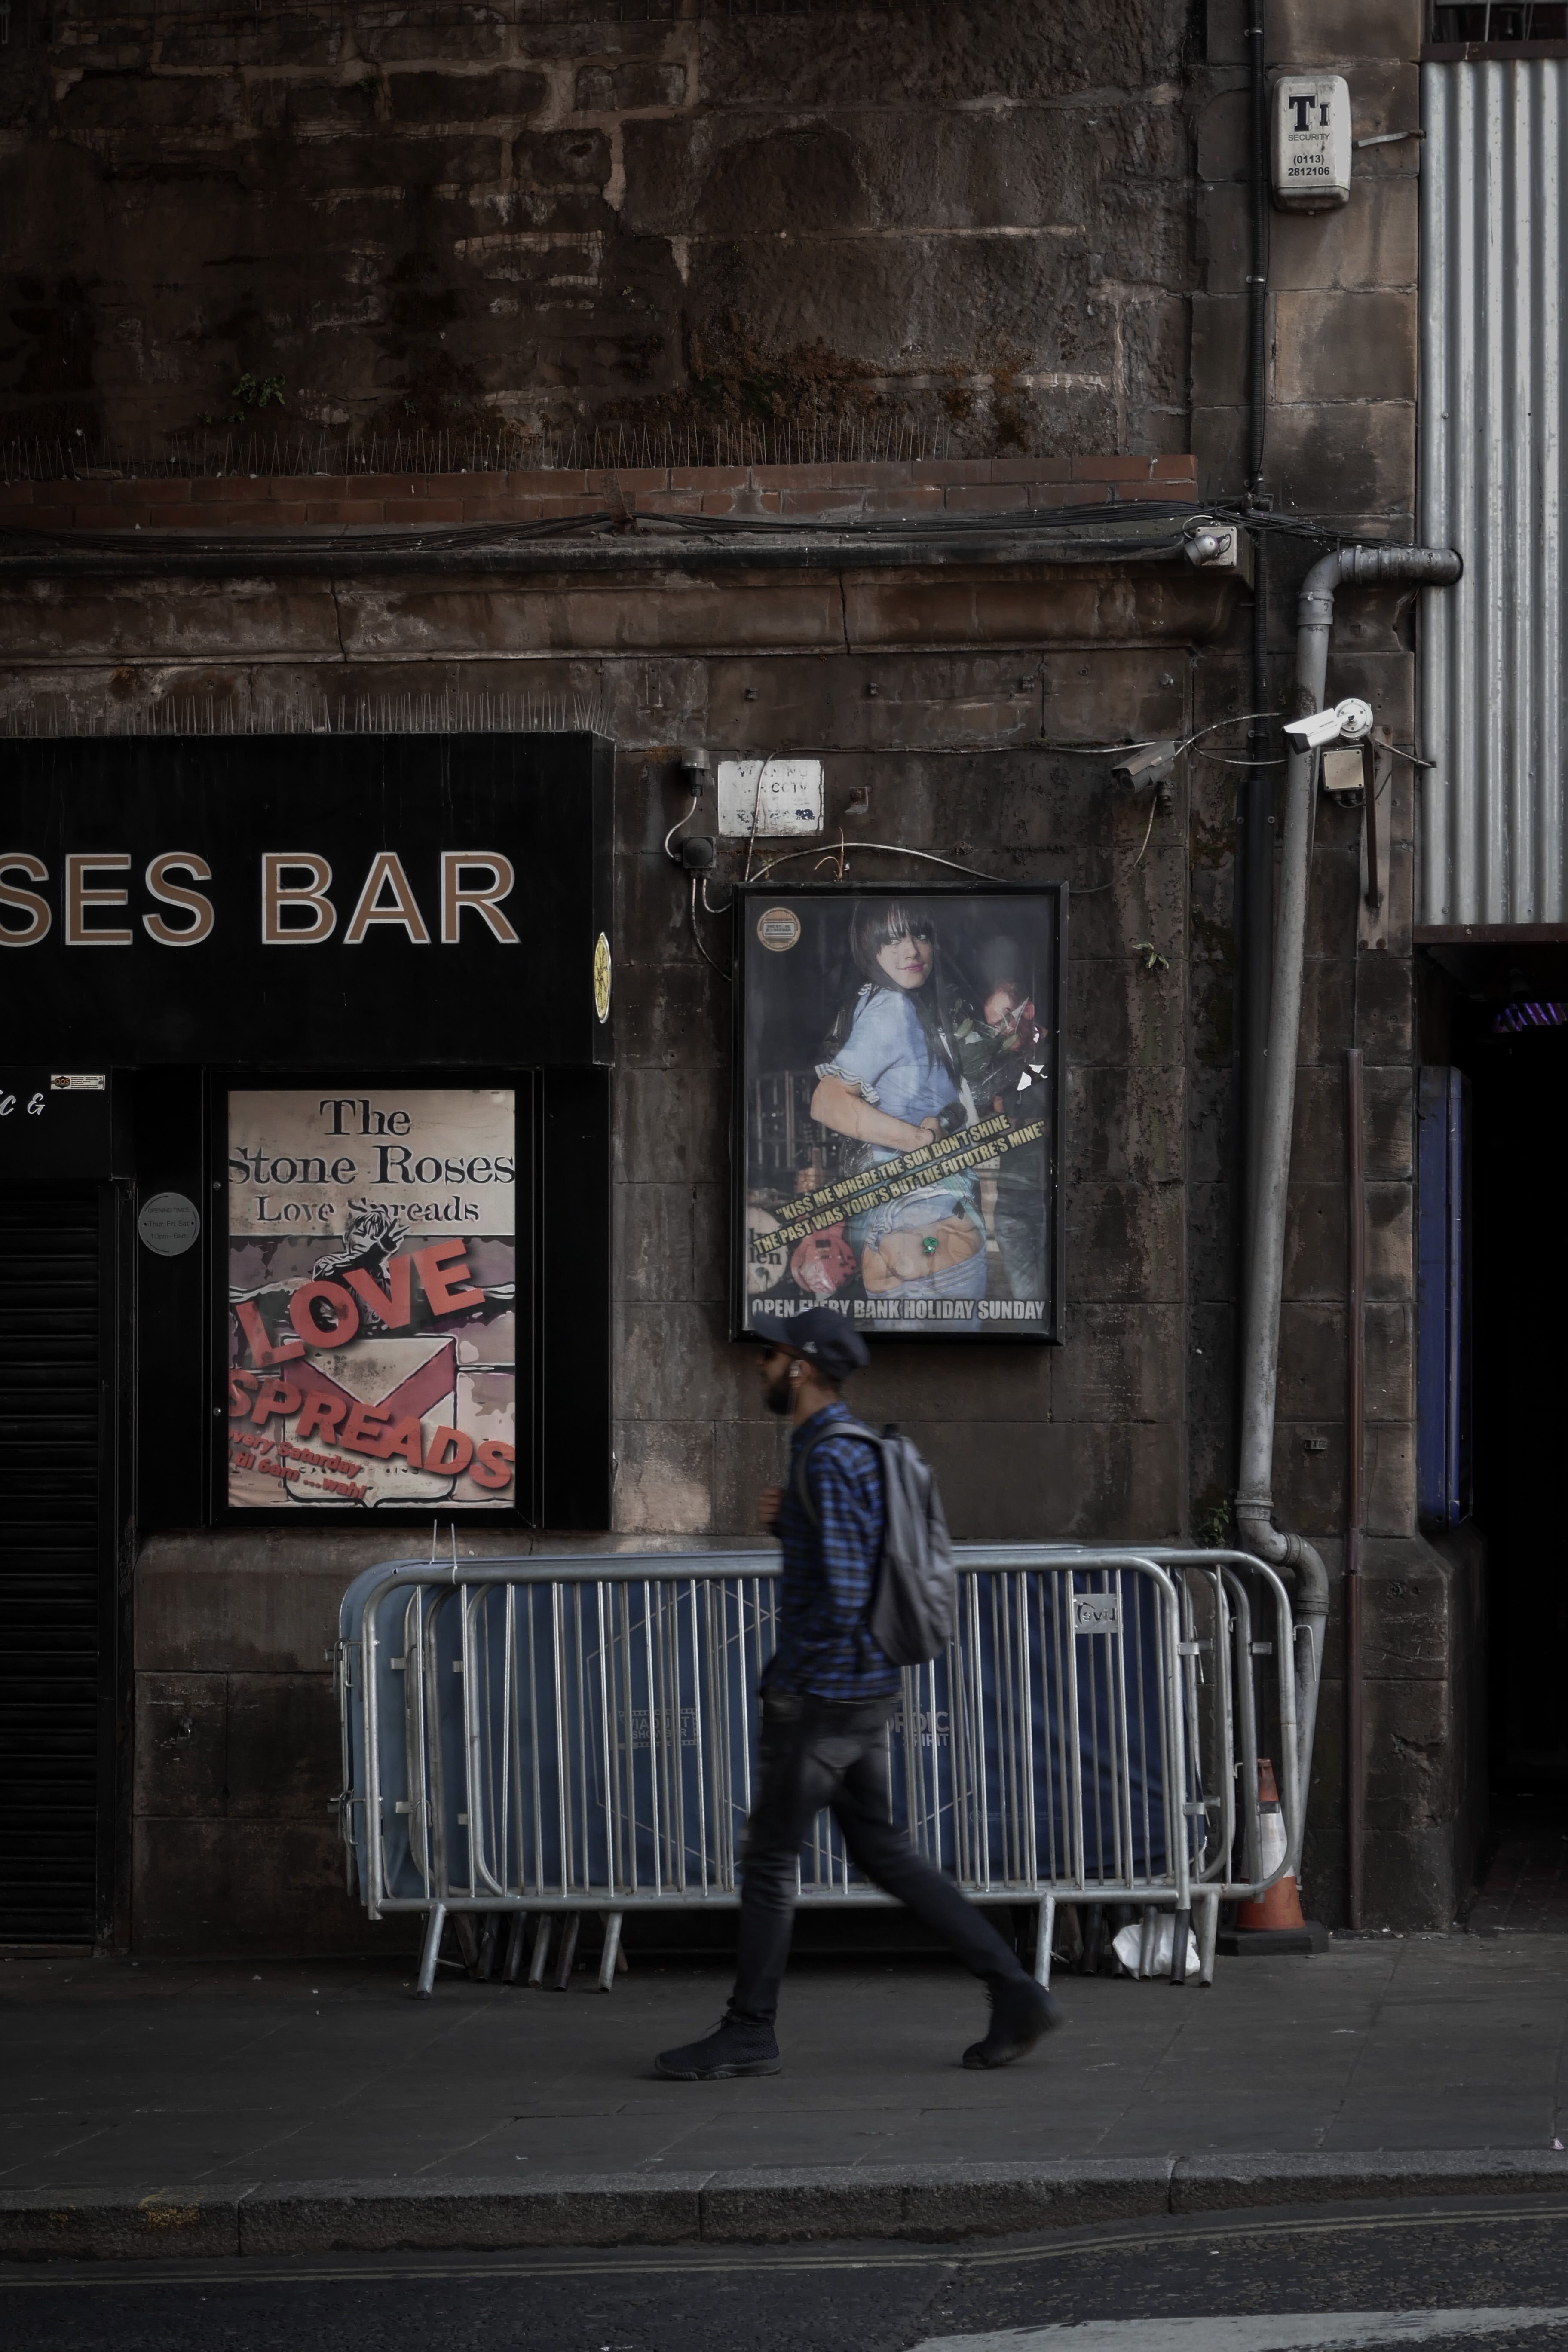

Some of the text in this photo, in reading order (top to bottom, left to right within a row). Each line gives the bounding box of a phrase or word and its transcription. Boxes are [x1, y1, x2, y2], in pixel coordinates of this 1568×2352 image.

[1288, 167, 1329, 176] 2812106
[1293, 155, 1324, 165] (0113)
[261, 851, 521, 945] BAR
[27, 1093, 46, 1115] &
[320, 1099, 411, 1136] The
[228, 1145, 515, 1184] Stone Roses
[812, 1188, 835, 1208] ME
[833, 1170, 880, 1200] WHERE
[878, 1158, 904, 1180] THE
[903, 1145, 932, 1170] SUN
[931, 1131, 971, 1158] DON'T
[969, 1114, 1011, 1142] SHINE
[255, 1195, 335, 1222] Love
[753, 1233, 781, 1255] THE
[779, 1220, 814, 1244] PAST
[812, 1207, 844, 1231] WAS
[842, 1187, 890, 1217] YOUR'S
[889, 1175, 917, 1198] BUT
[915, 1164, 943, 1186] THE
[235, 1239, 486, 1367] LOVE
[753, 1299, 795, 1318] OPEN
[854, 1299, 900, 1318] BANK
[903, 1300, 975, 1319] HOLIDAY
[977, 1300, 1046, 1319] SUNDAY
[228, 1369, 515, 1488] SPREADS
[258, 1459, 300, 1482] 6am
[278, 1441, 361, 1478] Saturday
